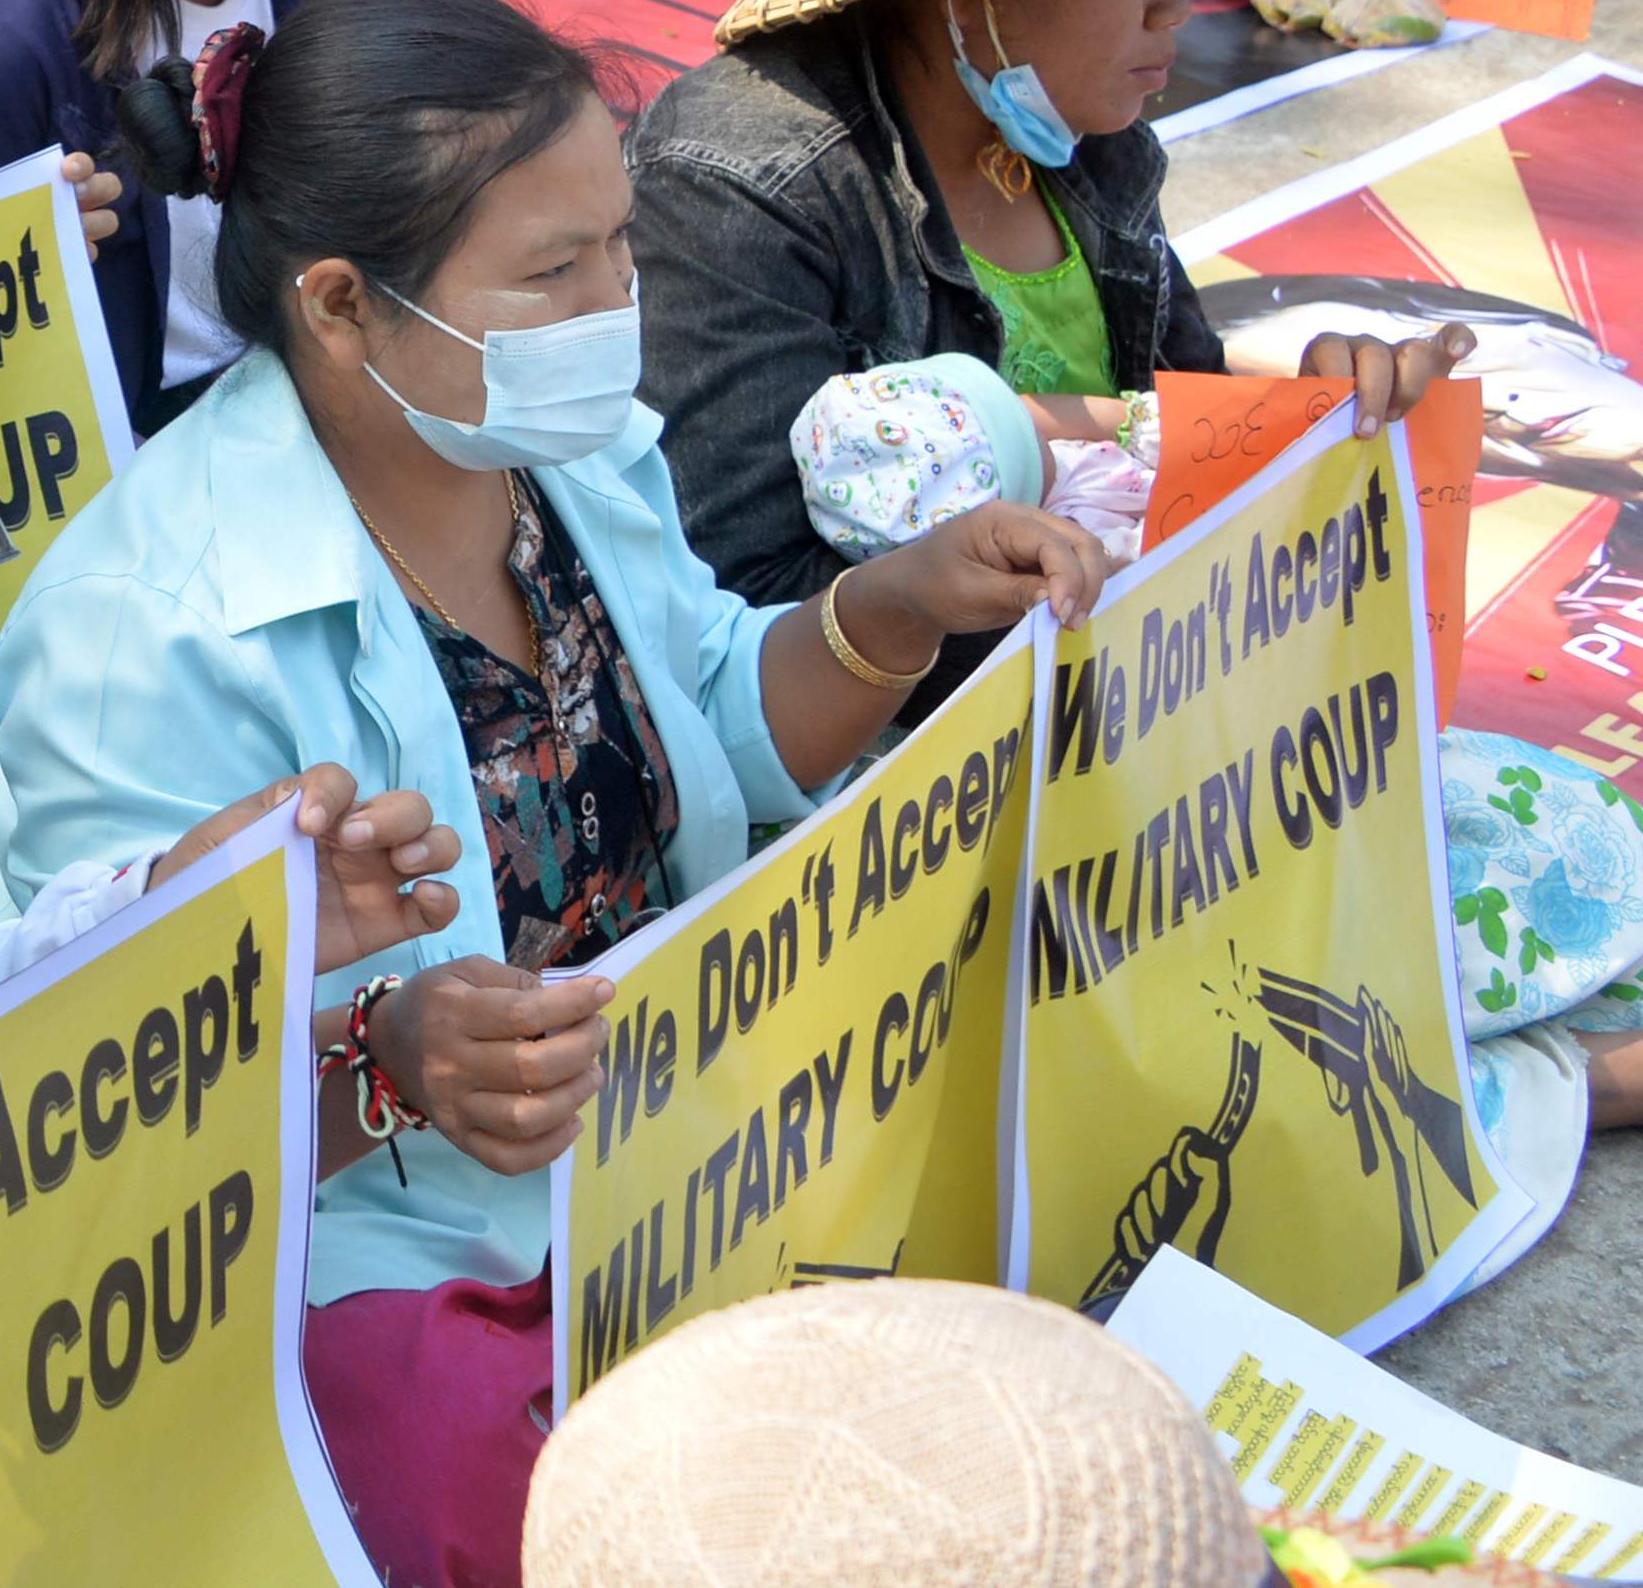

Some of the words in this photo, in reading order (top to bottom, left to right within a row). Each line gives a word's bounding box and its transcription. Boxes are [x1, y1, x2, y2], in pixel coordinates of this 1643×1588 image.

[1047, 649, 1125, 784] We
[1136, 554, 1236, 741] Don't
[1241, 463, 1392, 661] Accept
[595, 994, 676, 1169] We
[695, 840, 838, 1076] Don't
[847, 724, 1025, 940] Accep
[1028, 743, 1255, 1008] MILITARY
[1270, 669, 1401, 852] COUP
[578, 1025, 855, 1396] MILITARY
[870, 886, 991, 1124] COUP
[24, 1167, 256, 1456] COUP
